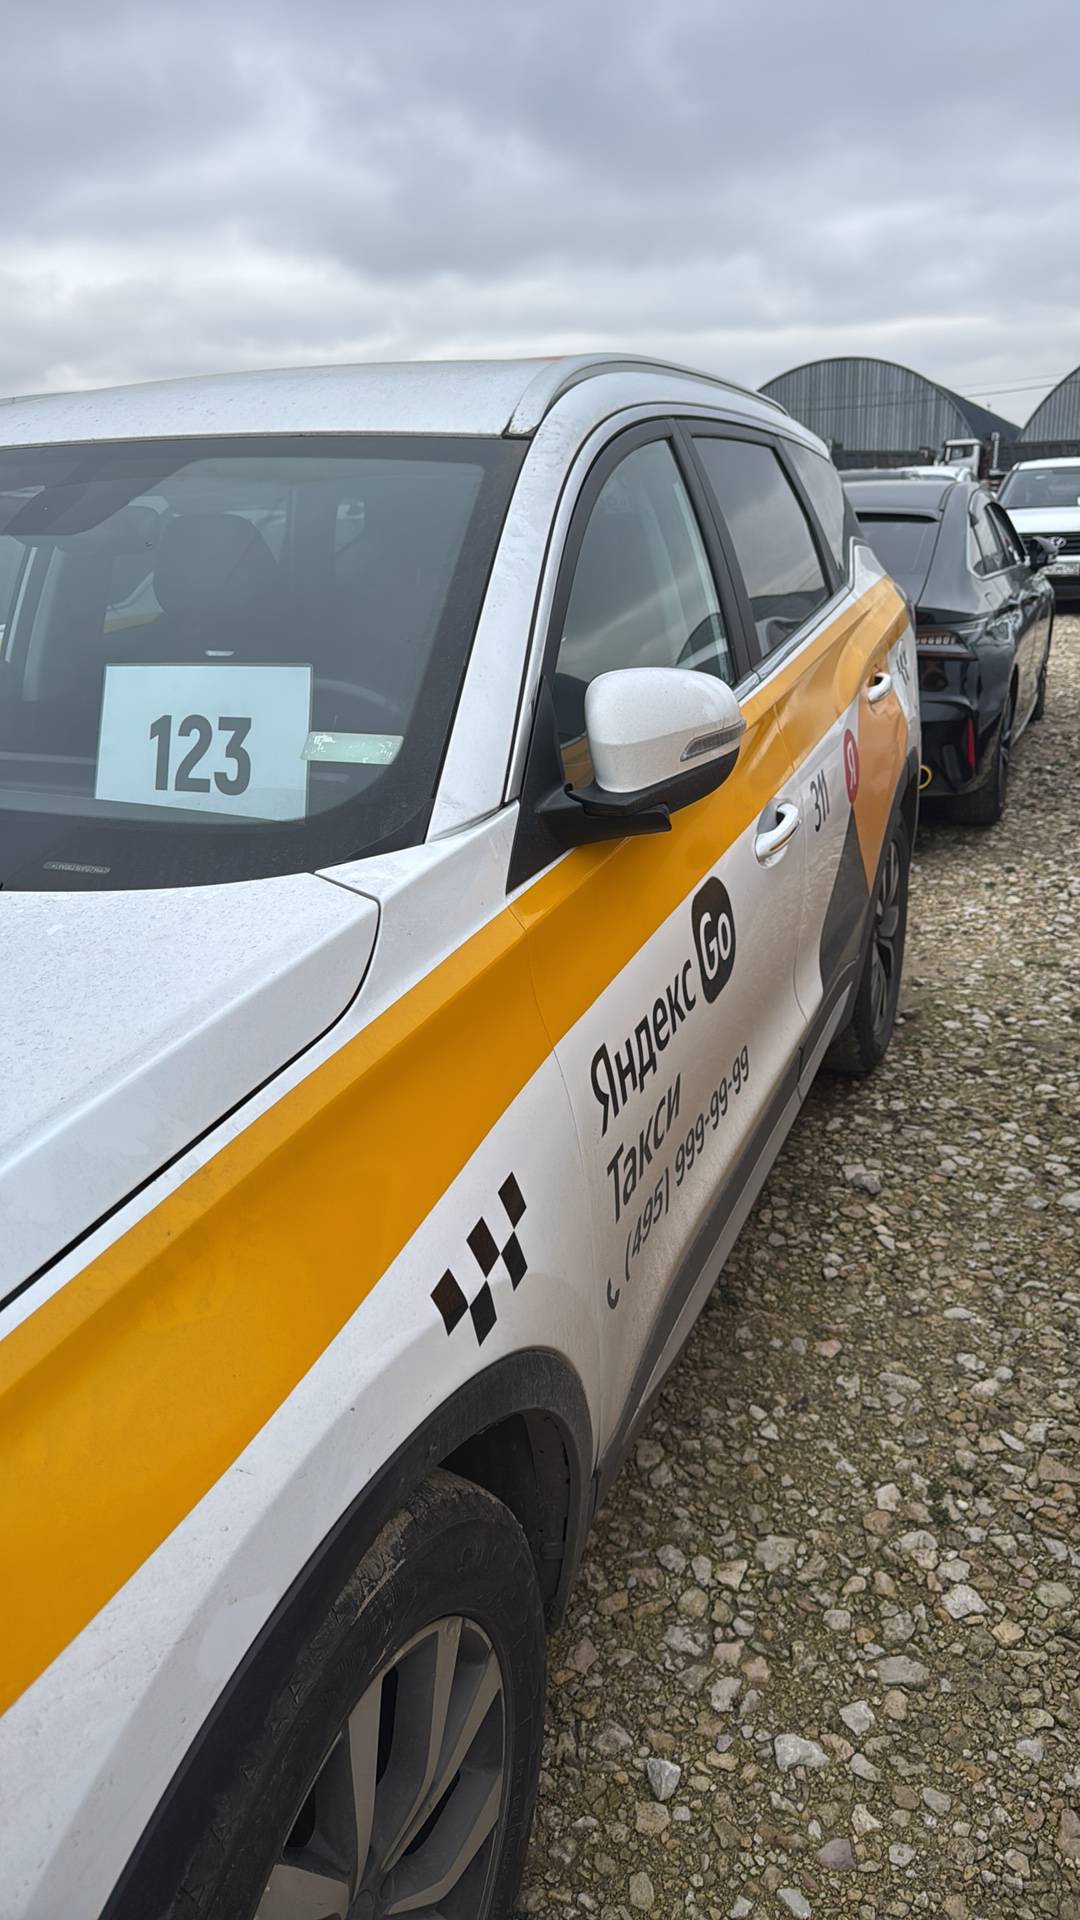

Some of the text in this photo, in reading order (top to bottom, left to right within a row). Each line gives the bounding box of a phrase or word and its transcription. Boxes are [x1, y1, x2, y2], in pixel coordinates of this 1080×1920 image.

[149, 714, 252, 796] 123
[810, 769, 830, 832] 311
[591, 912, 732, 1137] Яндекс Go
[607, 1073, 681, 1223] Такси
[625, 1045, 750, 1281] (495) 999-99-99
